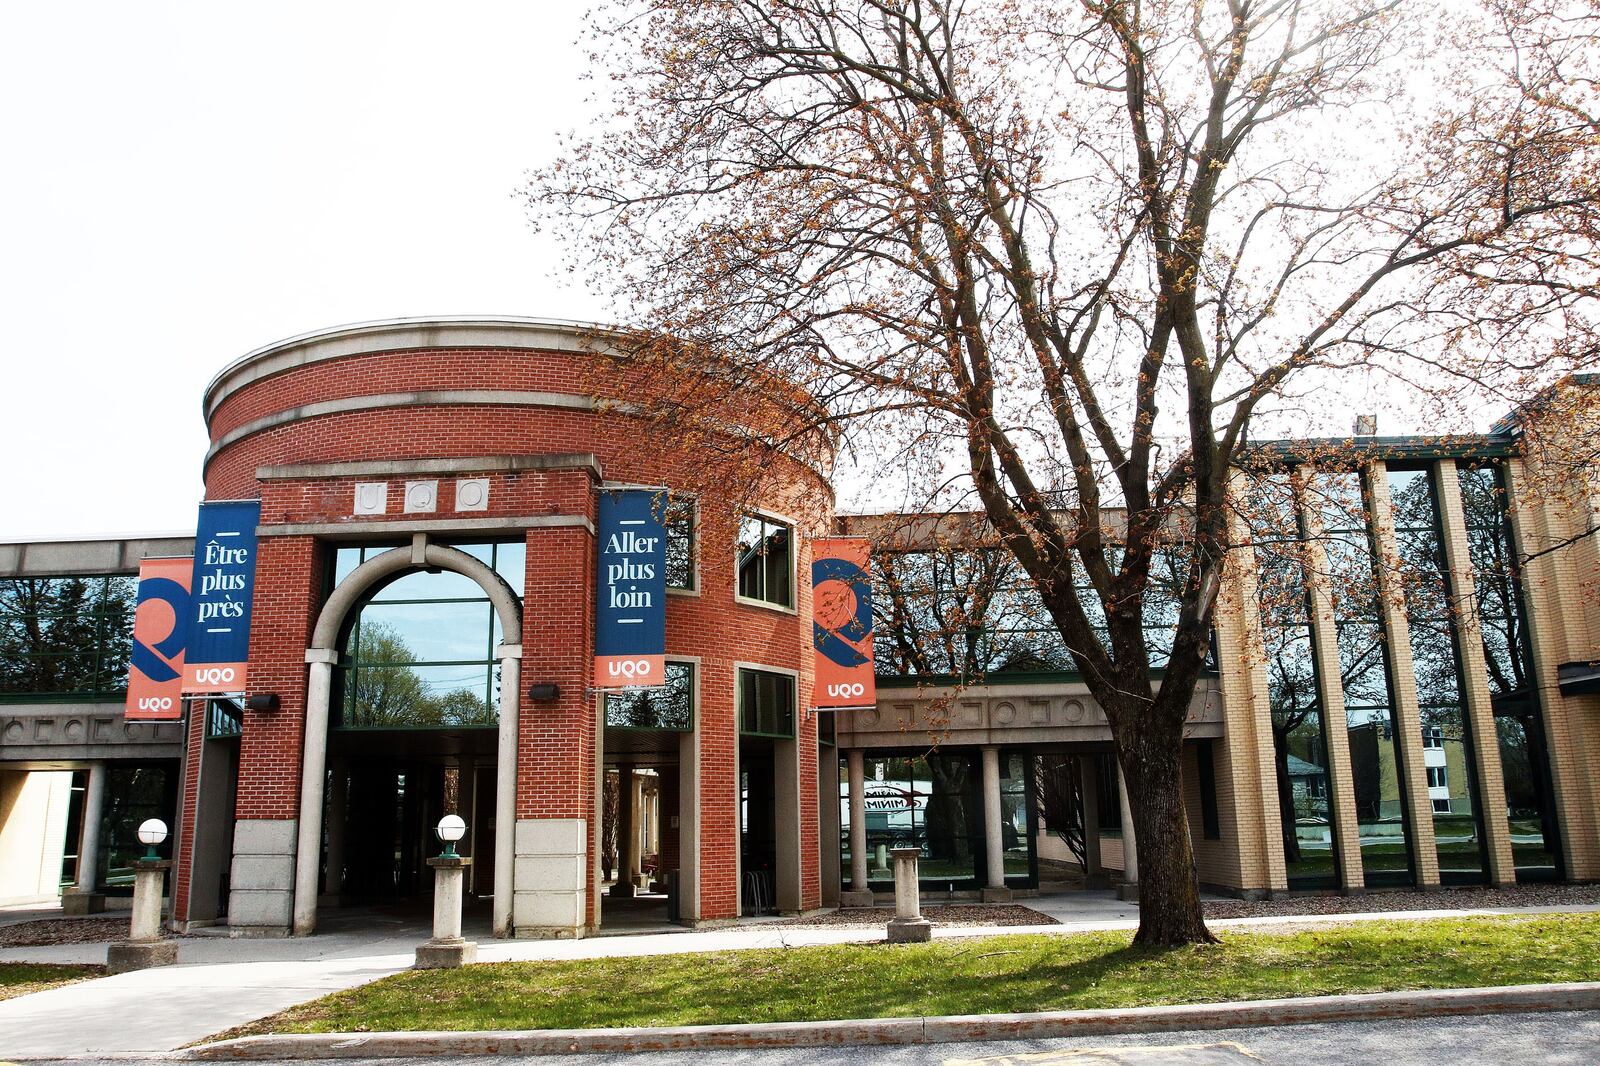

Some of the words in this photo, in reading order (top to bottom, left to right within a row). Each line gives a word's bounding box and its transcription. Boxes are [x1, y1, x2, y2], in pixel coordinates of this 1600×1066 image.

[359, 481, 484, 510] UQO
[203, 539, 248, 565] Être
[604, 531, 659, 554] Aller
[200, 568, 246, 596] plus
[607, 557, 655, 585] plus
[608, 585, 653, 608] loin
[197, 594, 244, 623] près
[195, 667, 235, 685] UQO
[608, 659, 651, 678] UQO
[827, 683, 865, 699] UQO
[138, 696, 173, 713] UQO
